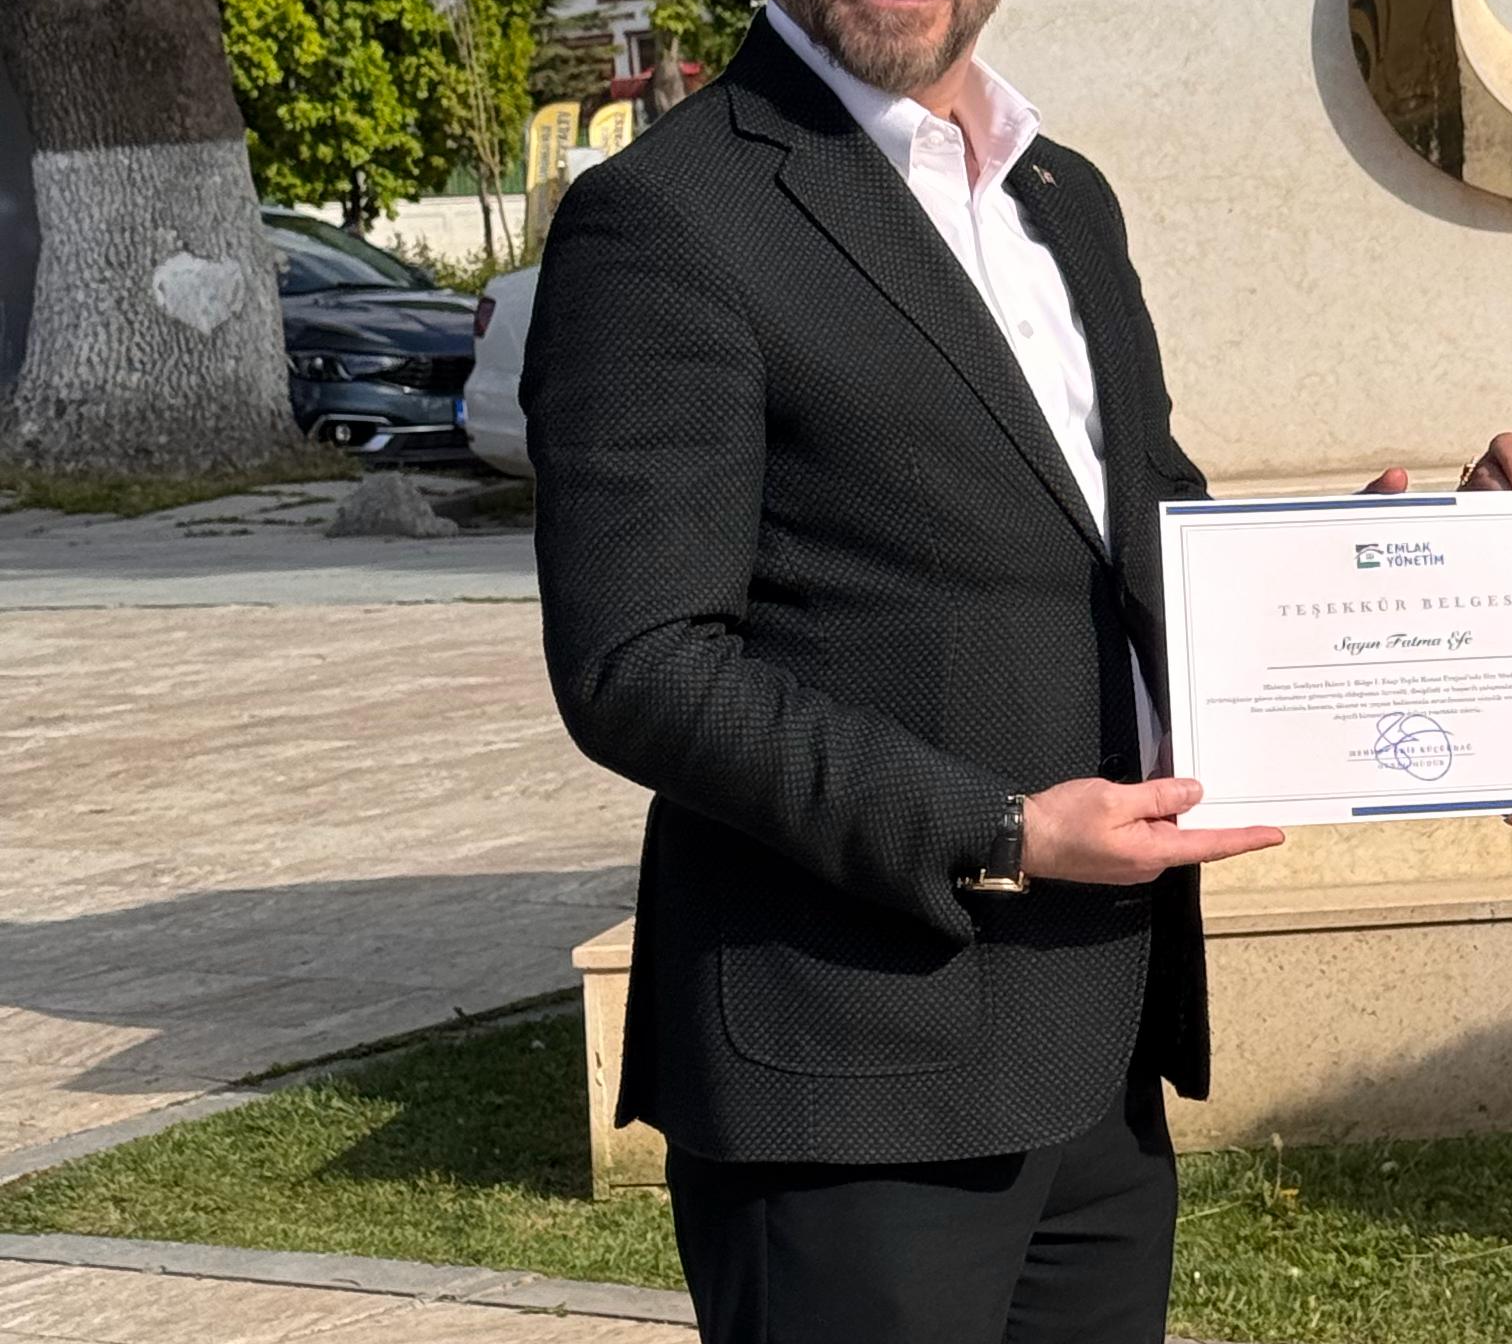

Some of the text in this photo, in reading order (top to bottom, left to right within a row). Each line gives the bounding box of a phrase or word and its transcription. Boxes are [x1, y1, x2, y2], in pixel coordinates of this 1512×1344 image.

[1386, 541, 1431, 554] EMLAK
[1278, 596, 1407, 619] TEŞEKKÜR
[1385, 633, 1443, 649] Fatma
